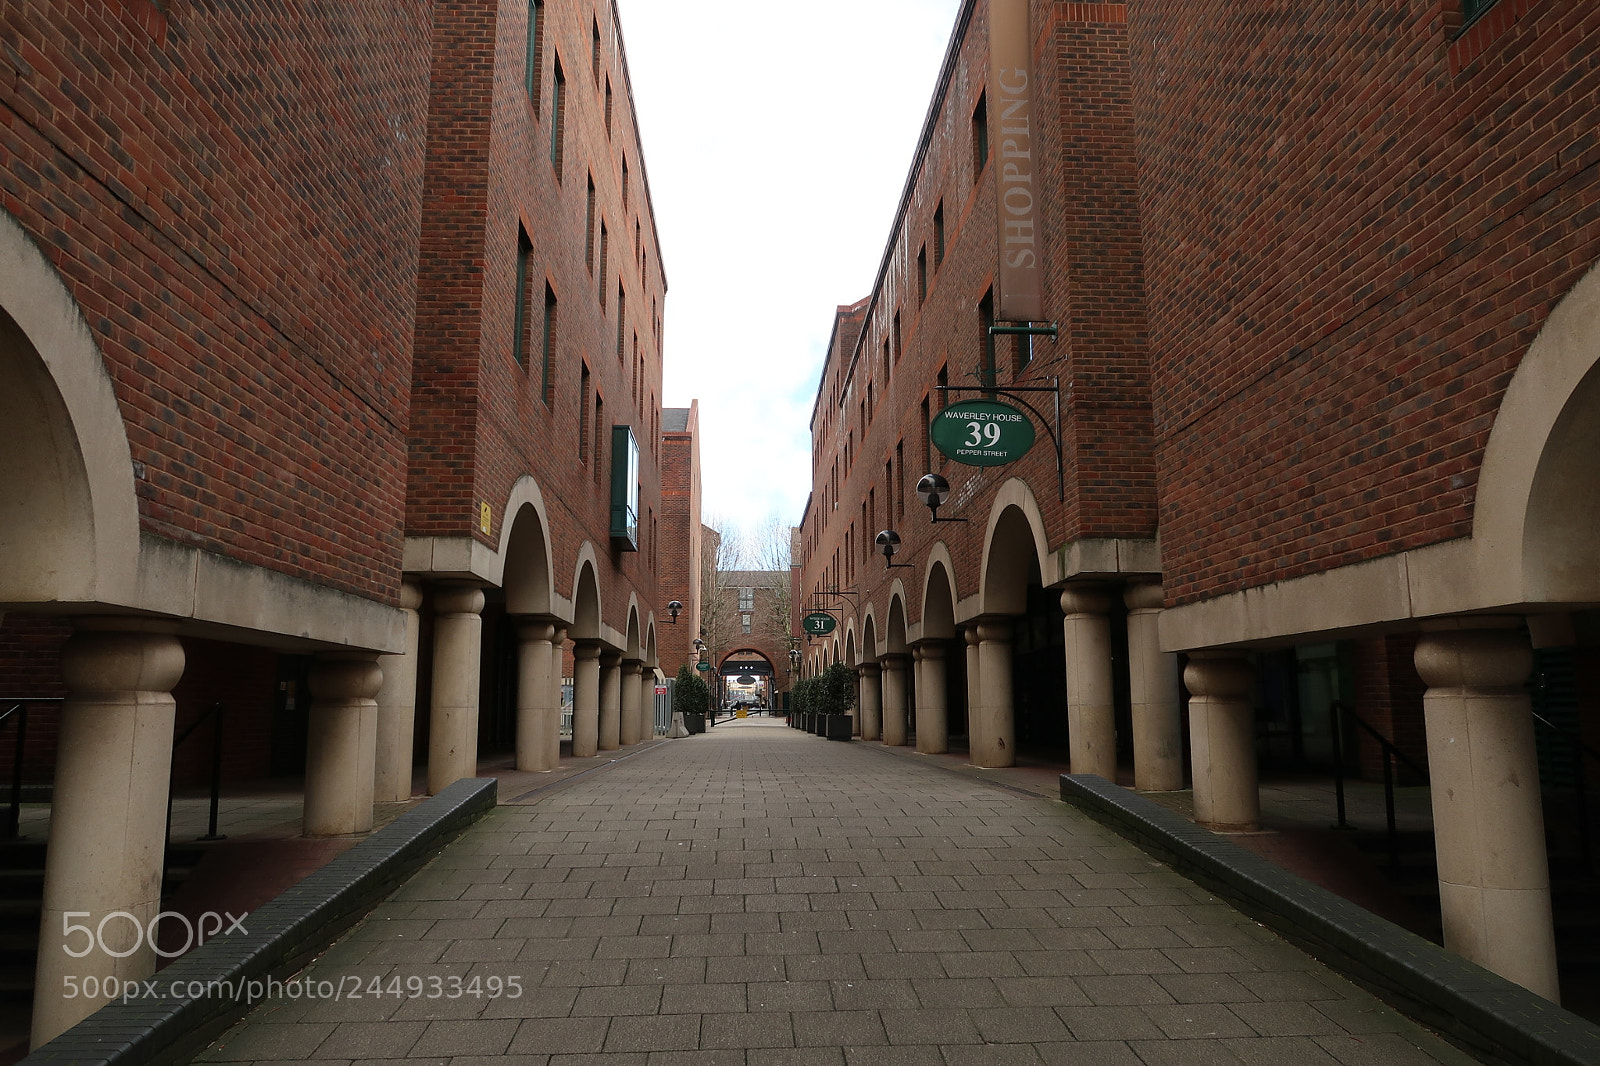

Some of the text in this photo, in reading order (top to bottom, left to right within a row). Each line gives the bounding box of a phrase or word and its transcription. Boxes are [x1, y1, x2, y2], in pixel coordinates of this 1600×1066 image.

[998, 66, 1036, 269] SHOPPING
[944, 411, 1023, 423] WAVERLEY HOUSE
[964, 421, 1001, 448] 39
[813, 620, 825, 630] 31
